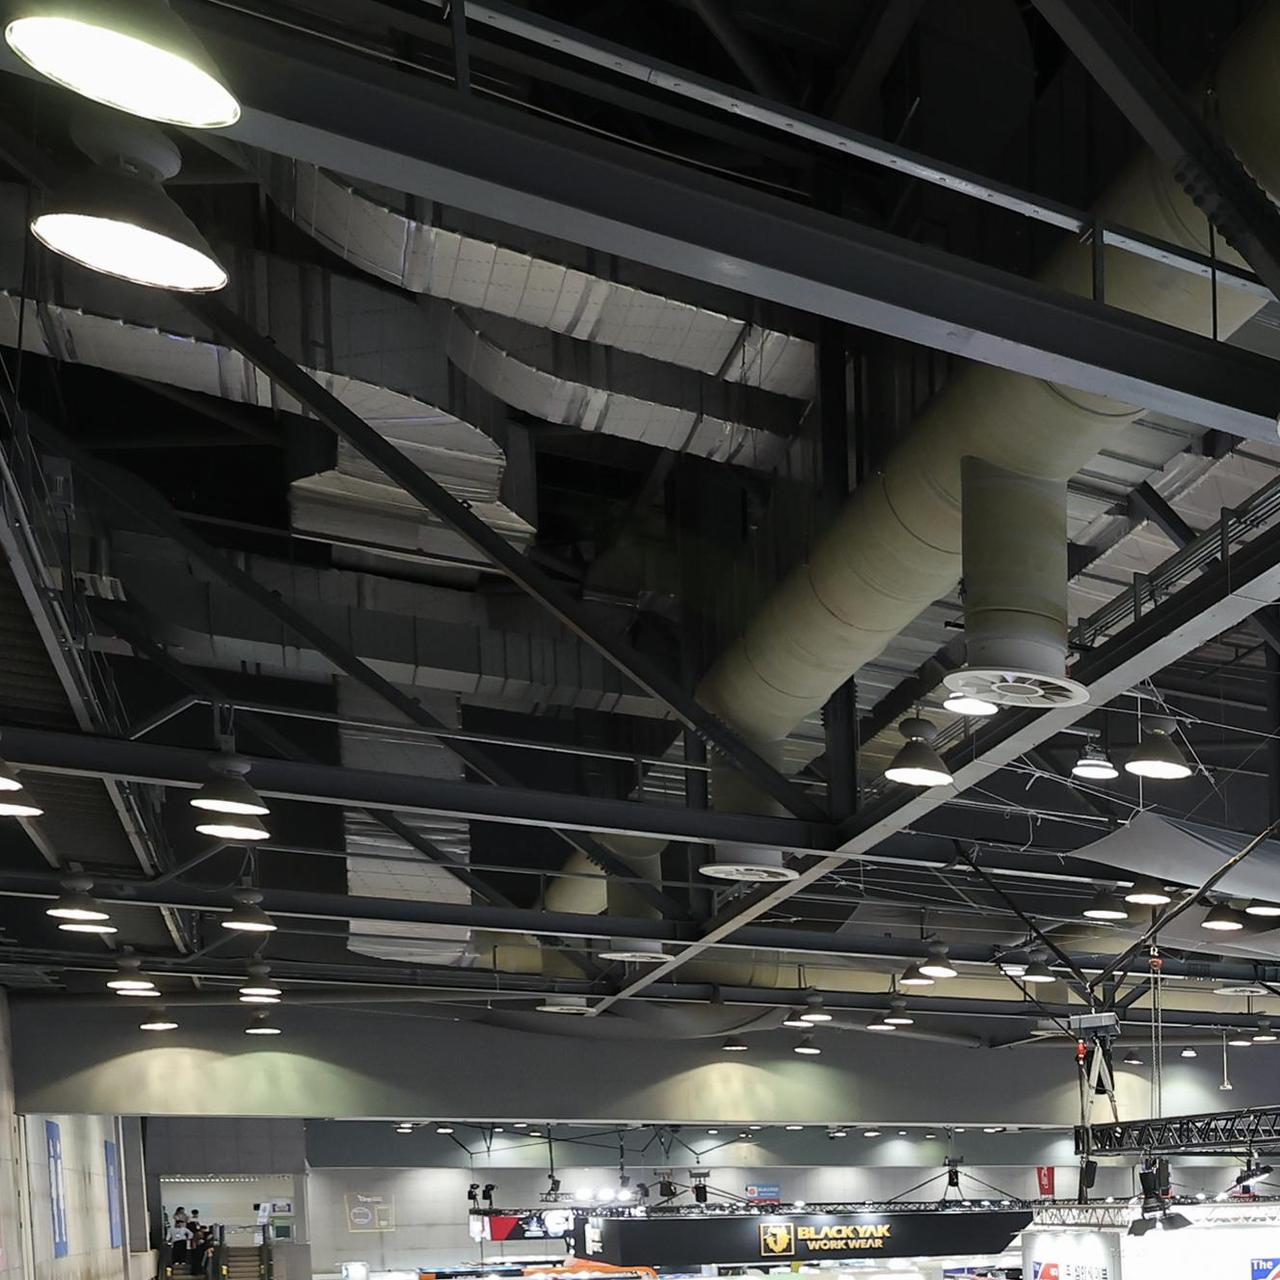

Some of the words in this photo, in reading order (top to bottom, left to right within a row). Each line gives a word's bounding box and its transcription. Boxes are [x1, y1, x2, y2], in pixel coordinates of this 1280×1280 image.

[806, 1240, 847, 1250] WORK
[847, 1239, 884, 1249] WEAR
[1252, 1259, 1273, 1270] The
